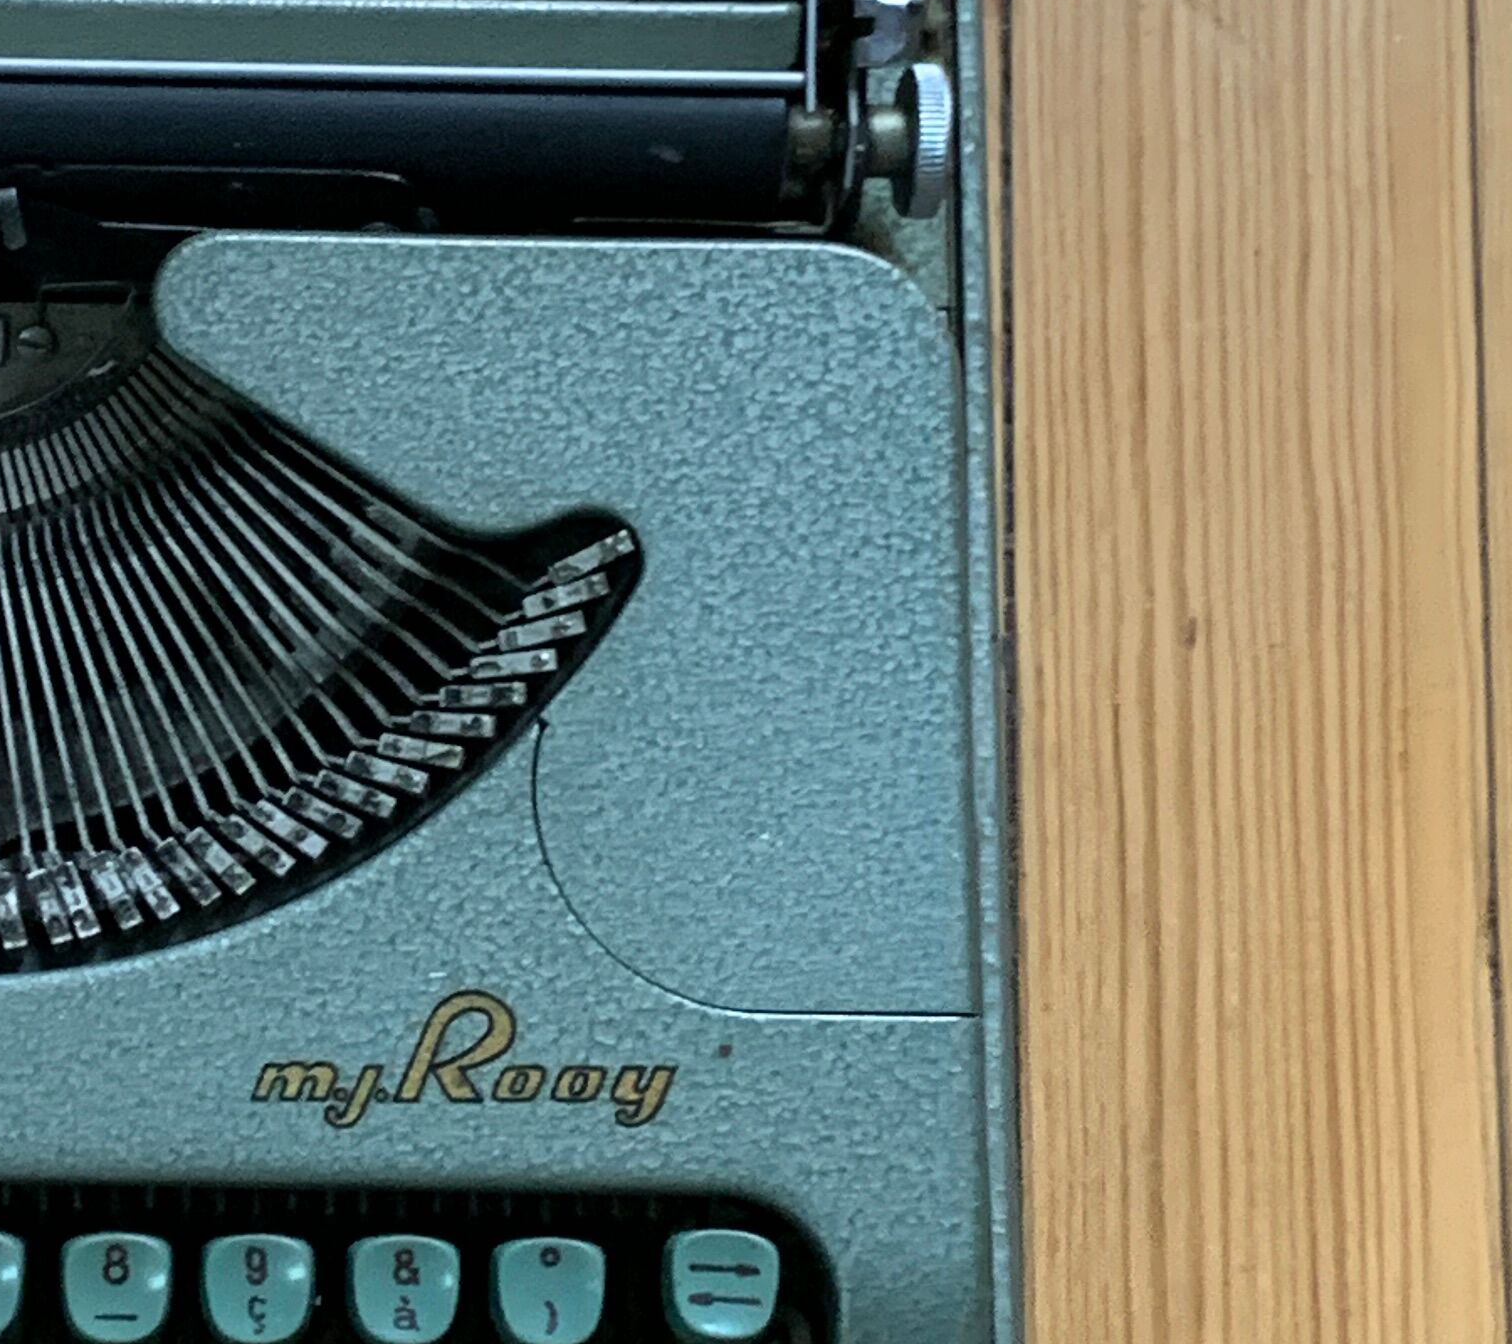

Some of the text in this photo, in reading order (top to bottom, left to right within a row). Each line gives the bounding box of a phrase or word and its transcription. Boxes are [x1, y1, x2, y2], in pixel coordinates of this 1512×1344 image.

[102, 1243, 130, 1285] 8
[245, 1246, 268, 1286] 9
[394, 1248, 421, 1286] &
[247, 1295, 268, 1335] ç
[394, 1295, 421, 1332] à
[543, 1300, 557, 1335] )
